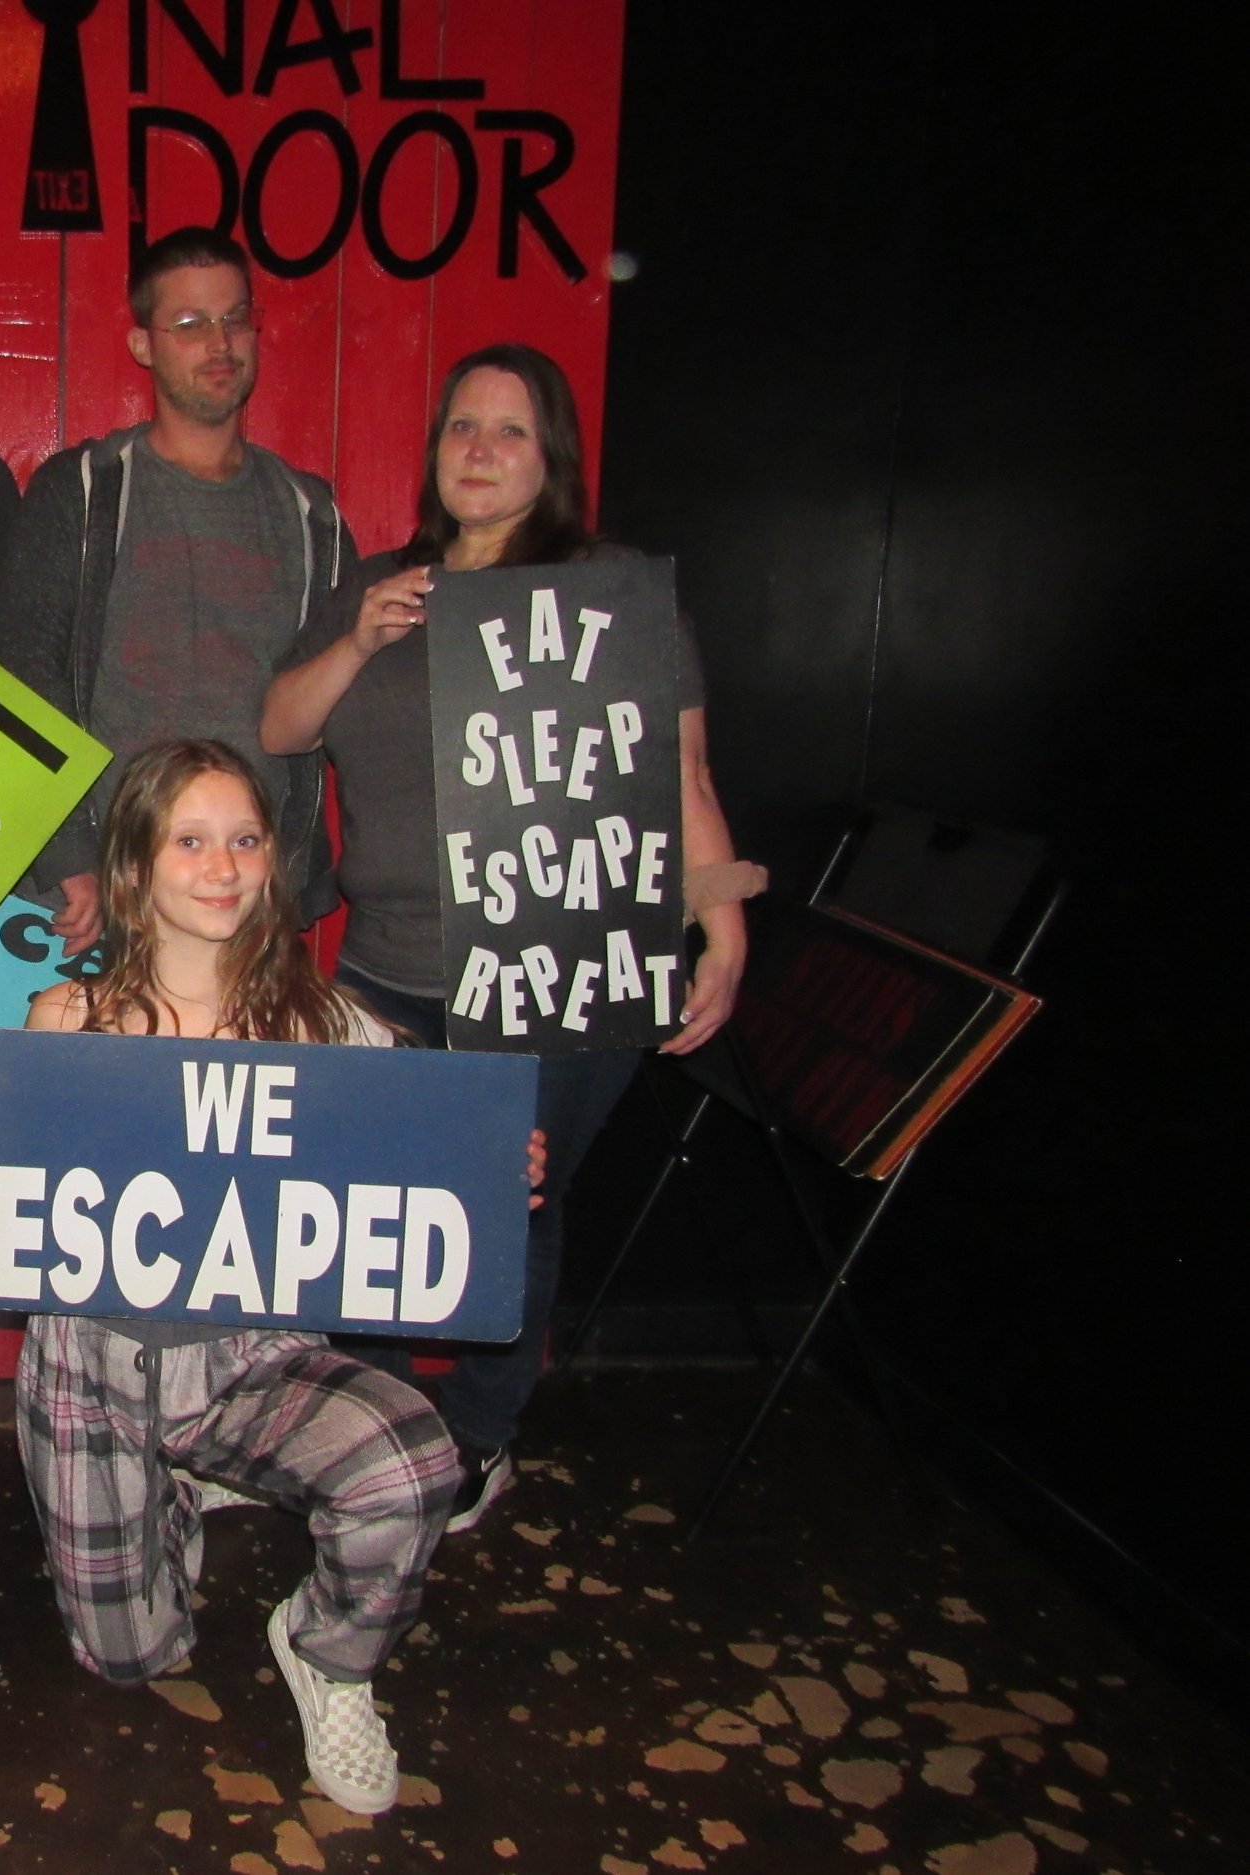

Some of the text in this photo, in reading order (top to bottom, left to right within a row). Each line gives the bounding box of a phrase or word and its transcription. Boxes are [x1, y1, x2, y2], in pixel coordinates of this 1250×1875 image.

[127, 105, 588, 285] DOOR
[478, 588, 613, 692] EAT
[462, 701, 643, 806] SLEEP
[446, 815, 668, 925] ESCAPE
[451, 929, 677, 1037] REPEAT
[182, 1061, 296, 1157] WE
